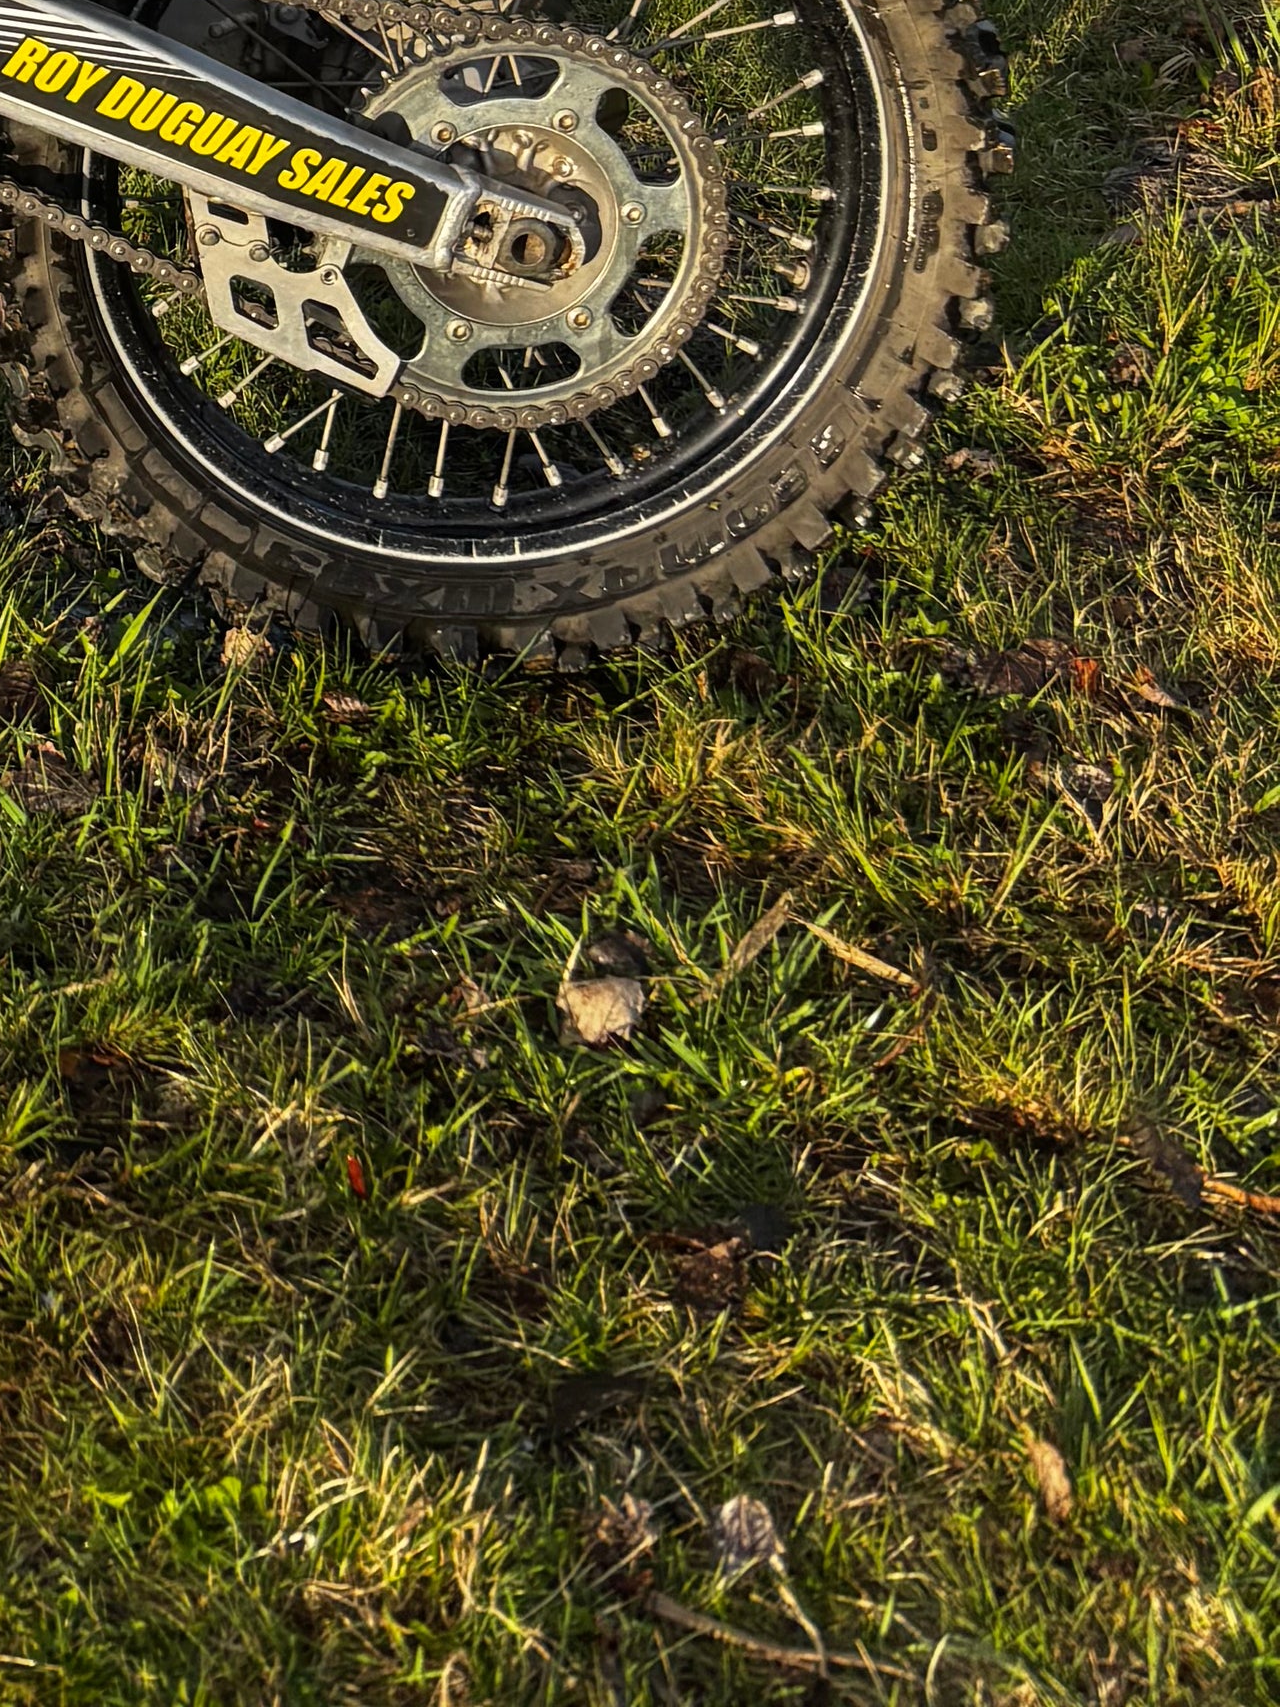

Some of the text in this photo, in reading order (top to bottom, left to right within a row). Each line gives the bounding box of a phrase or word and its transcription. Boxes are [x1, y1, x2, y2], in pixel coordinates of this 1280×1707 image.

[0, 37, 417, 224] ROY DUGUAY SALES
